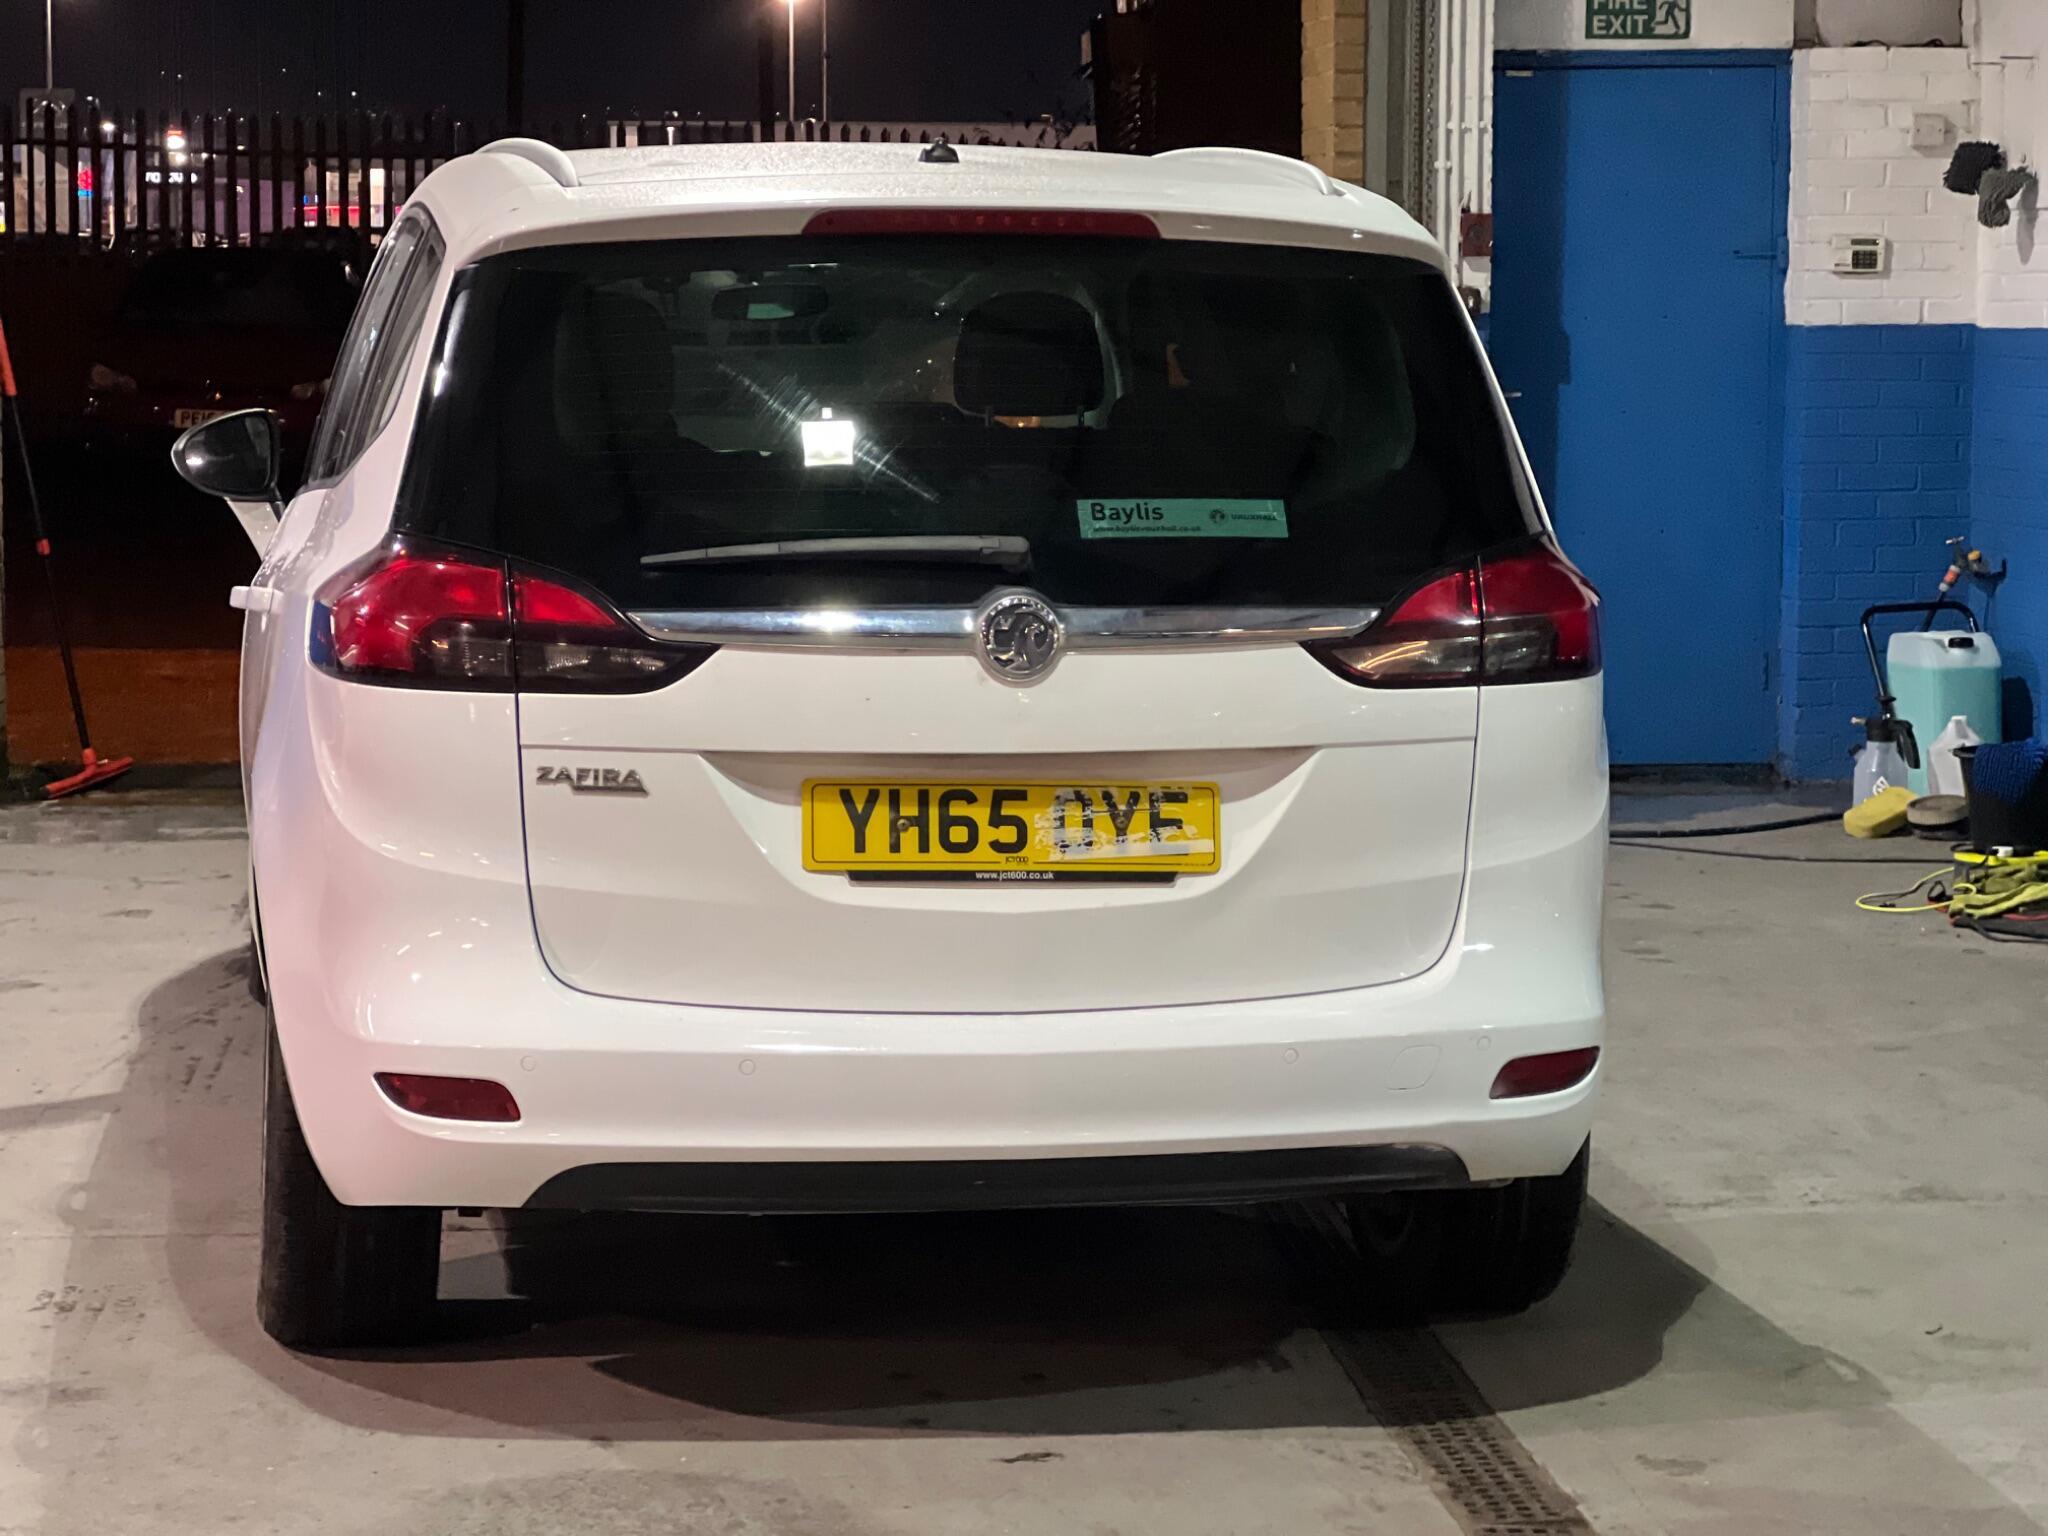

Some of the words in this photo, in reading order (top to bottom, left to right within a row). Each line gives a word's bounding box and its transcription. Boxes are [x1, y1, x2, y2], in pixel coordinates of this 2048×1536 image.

[1593, 15, 1648, 35] EXIT
[1090, 502, 1164, 525] Baylis
[536, 766, 648, 795] ZAFIRA
[838, 788, 1028, 854] YH65
[975, 871, 1054, 881] www.jct600.co.uk
